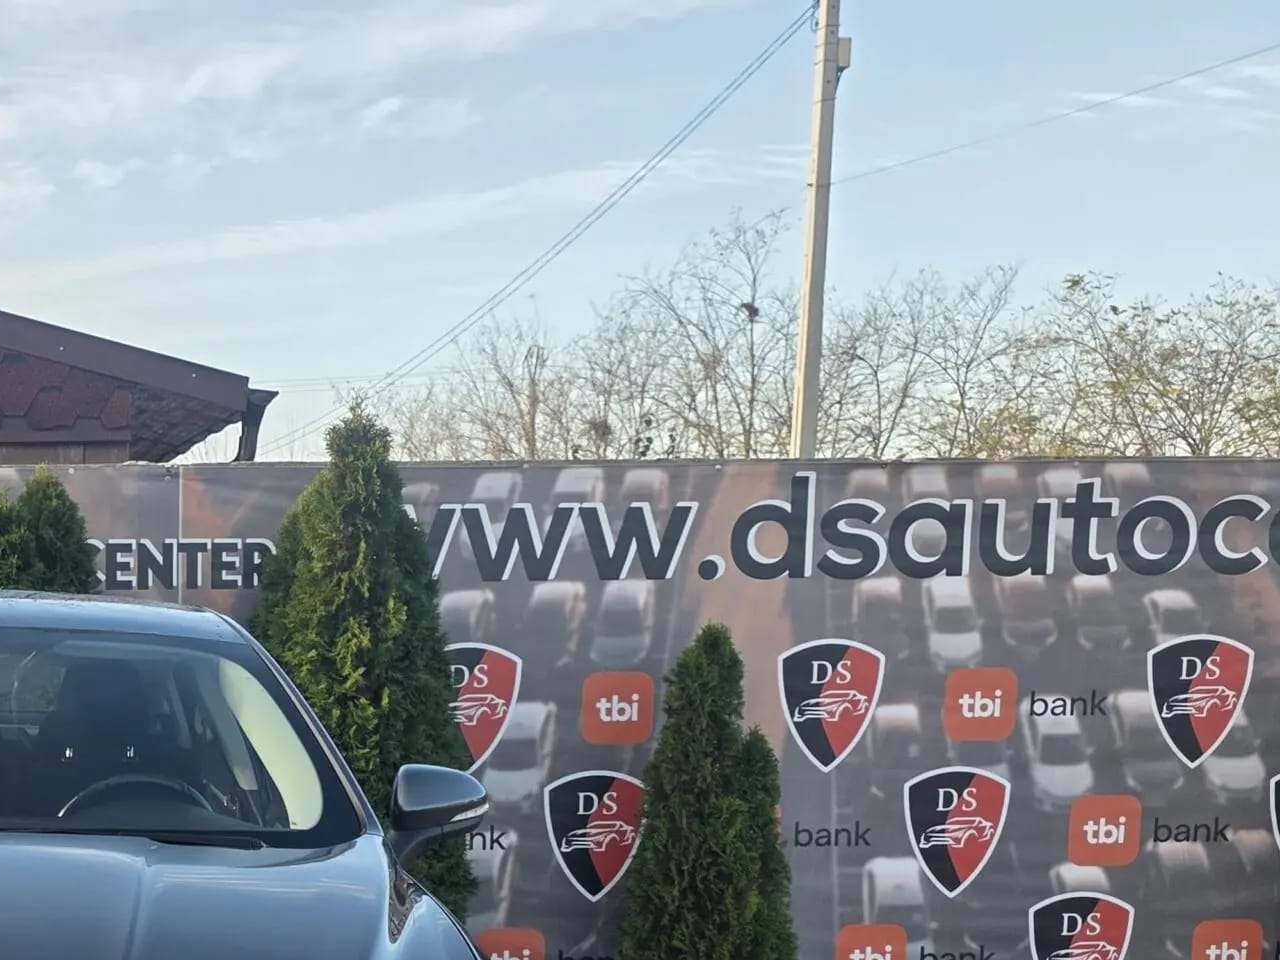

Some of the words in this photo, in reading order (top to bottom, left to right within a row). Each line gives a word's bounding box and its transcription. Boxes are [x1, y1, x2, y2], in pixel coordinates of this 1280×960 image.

[400, 471, 1280, 582] ww.dsautoc
[810, 659, 852, 684] DS
[1179, 655, 1221, 680] DS
[595, 693, 640, 722] tbi
[958, 689, 1003, 719] tbi
[1029, 690, 1108, 718] bank
[576, 791, 618, 815] DS
[936, 787, 978, 812] DS
[469, 825, 507, 851] nk
[793, 821, 872, 848] bank
[1083, 816, 1127, 845] tbi
[1152, 817, 1231, 844] bank
[1061, 912, 1103, 937] DS
